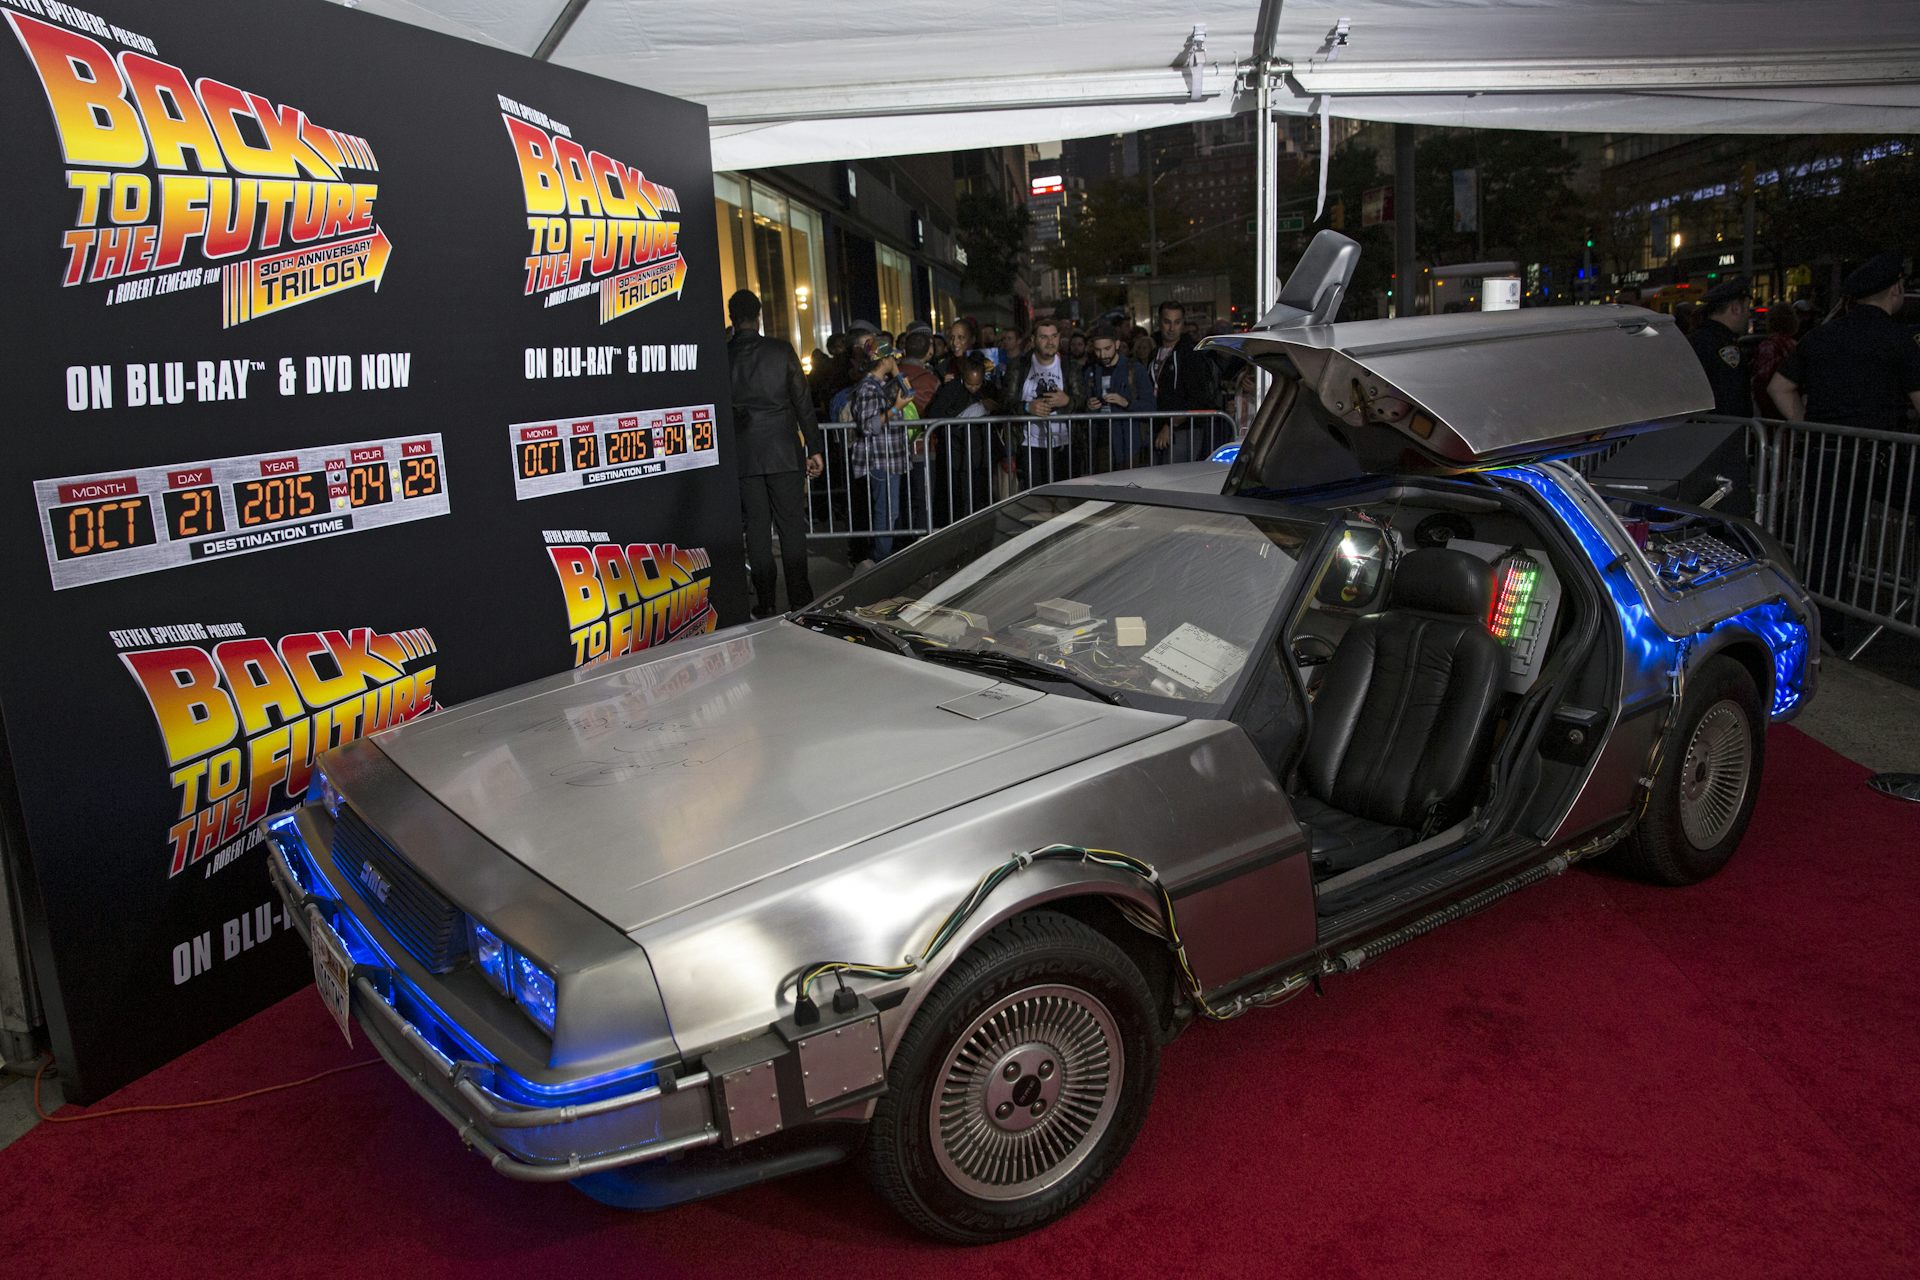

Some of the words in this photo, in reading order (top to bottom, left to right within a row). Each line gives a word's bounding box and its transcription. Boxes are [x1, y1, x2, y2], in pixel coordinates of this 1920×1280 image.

[42, 0, 113, 40] SPIELBERG
[110, 24, 158, 56] PRESENTS
[0, 7, 345, 181] BACK
[501, 112, 662, 221] BACK
[65, 170, 152, 227] TO
[62, 225, 158, 288] THE
[154, 174, 378, 270] FUTURE
[260, 258, 294, 277] 30TH
[297, 240, 372, 267] ANNIVERSARY
[524, 252, 570, 296] THE
[567, 218, 680, 284] FUTURE
[527, 217, 567, 255] TO
[106, 287, 114, 306] A
[116, 277, 157, 305] ROBERT
[156, 268, 202, 296] ZEMECKIS
[203, 266, 220, 285] FILM
[261, 255, 369, 306] TRILOGY
[620, 272, 676, 309] TRILOGY
[637, 263, 677, 283] ANNIVERSARY
[66, 364, 113, 411] ON
[279, 357, 297, 396] &
[305, 355, 352, 394] DVD
[361, 352, 411, 391] NOW
[524, 347, 547, 380] ON
[628, 345, 637, 374] &
[641, 345, 667, 373] DVD
[670, 344, 698, 371] NOW
[524, 441, 560, 477] OCT
[576, 437, 594, 468] 21
[609, 430, 647, 463] 2015
[664, 426, 683, 455] 04
[693, 422, 711, 450] 29
[526, 428, 553, 438] MONTH
[576, 424, 590, 433] DAY
[620, 419, 636, 427] YEAR
[666, 414, 682, 422] HOUR
[72, 482, 126, 498] MONTH
[177, 472, 203, 486] DAY
[265, 459, 294, 472] YEAR
[327, 461, 344, 471] AM
[353, 449, 382, 461] HOUR
[408, 443, 427, 454] MIN
[331, 486, 348, 496] PM
[588, 466, 642, 483] DESTINATION
[643, 463, 661, 475] TIME
[68, 499, 142, 554] OCT
[179, 489, 213, 536] 21
[243, 475, 315, 525] 2015
[350, 465, 384, 506] 04
[405, 458, 436, 497] 29
[203, 525, 306, 555] DESTINATION
[311, 518, 344, 540] TIME
[546, 543, 694, 631] BACK
[109, 627, 152, 649] STEVEN
[150, 623, 206, 645] SPIELBERG
[206, 622, 247, 639] PRESENTS
[570, 620, 607, 668] TO
[608, 576, 711, 661] FUTURE
[117, 627, 405, 768] BACK
[167, 789, 246, 879] THE
[244, 664, 436, 828] FUTURE
[170, 747, 242, 819] TO
[205, 862, 212, 880] A
[212, 836, 246, 875] ROBERT
[173, 931, 211, 986] ON
[223, 902, 294, 961] BLU-
